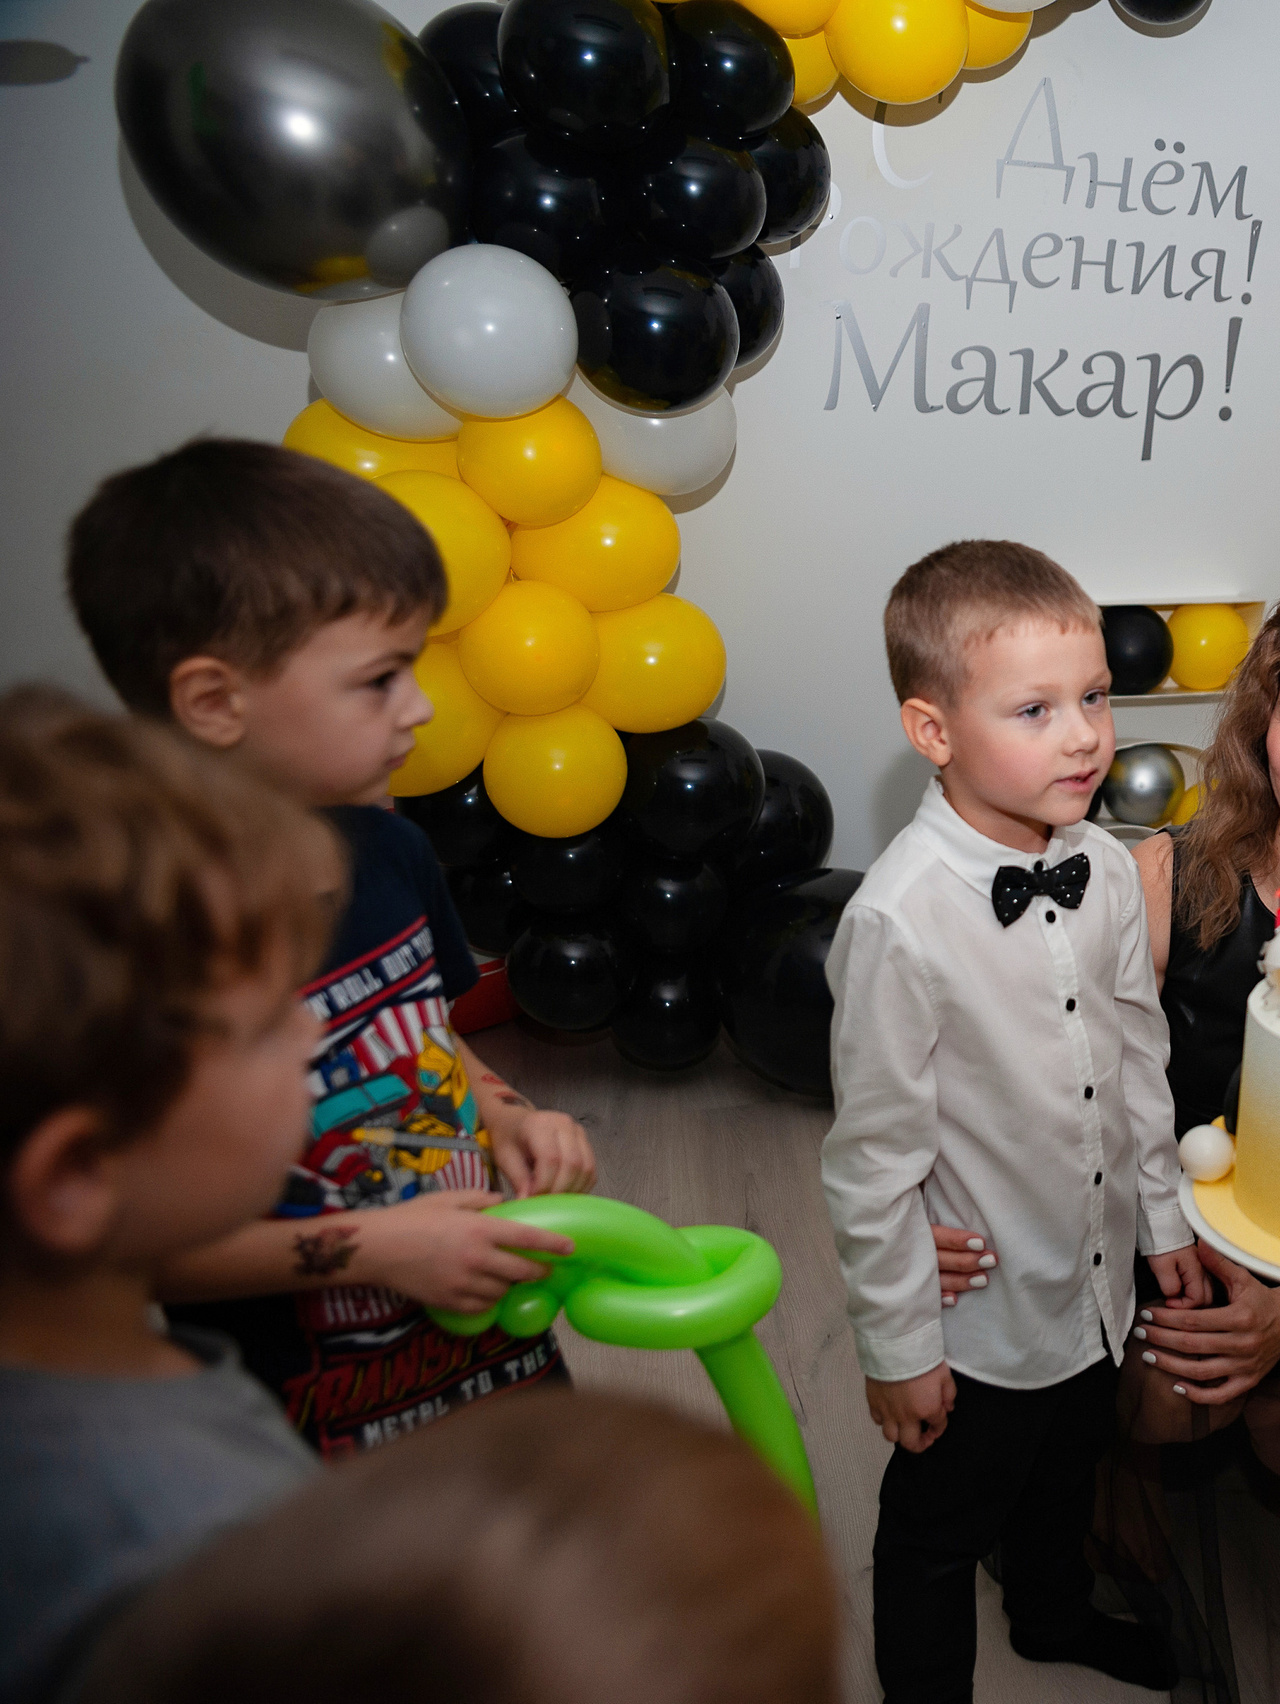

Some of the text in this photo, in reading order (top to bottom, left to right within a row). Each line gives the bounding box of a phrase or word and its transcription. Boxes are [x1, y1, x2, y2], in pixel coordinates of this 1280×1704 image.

[996, 77, 1254, 221] Днём
[823, 302, 1243, 461] Макар!
[460, 1369, 494, 1401] TO
[503, 1350, 548, 1382] THE
